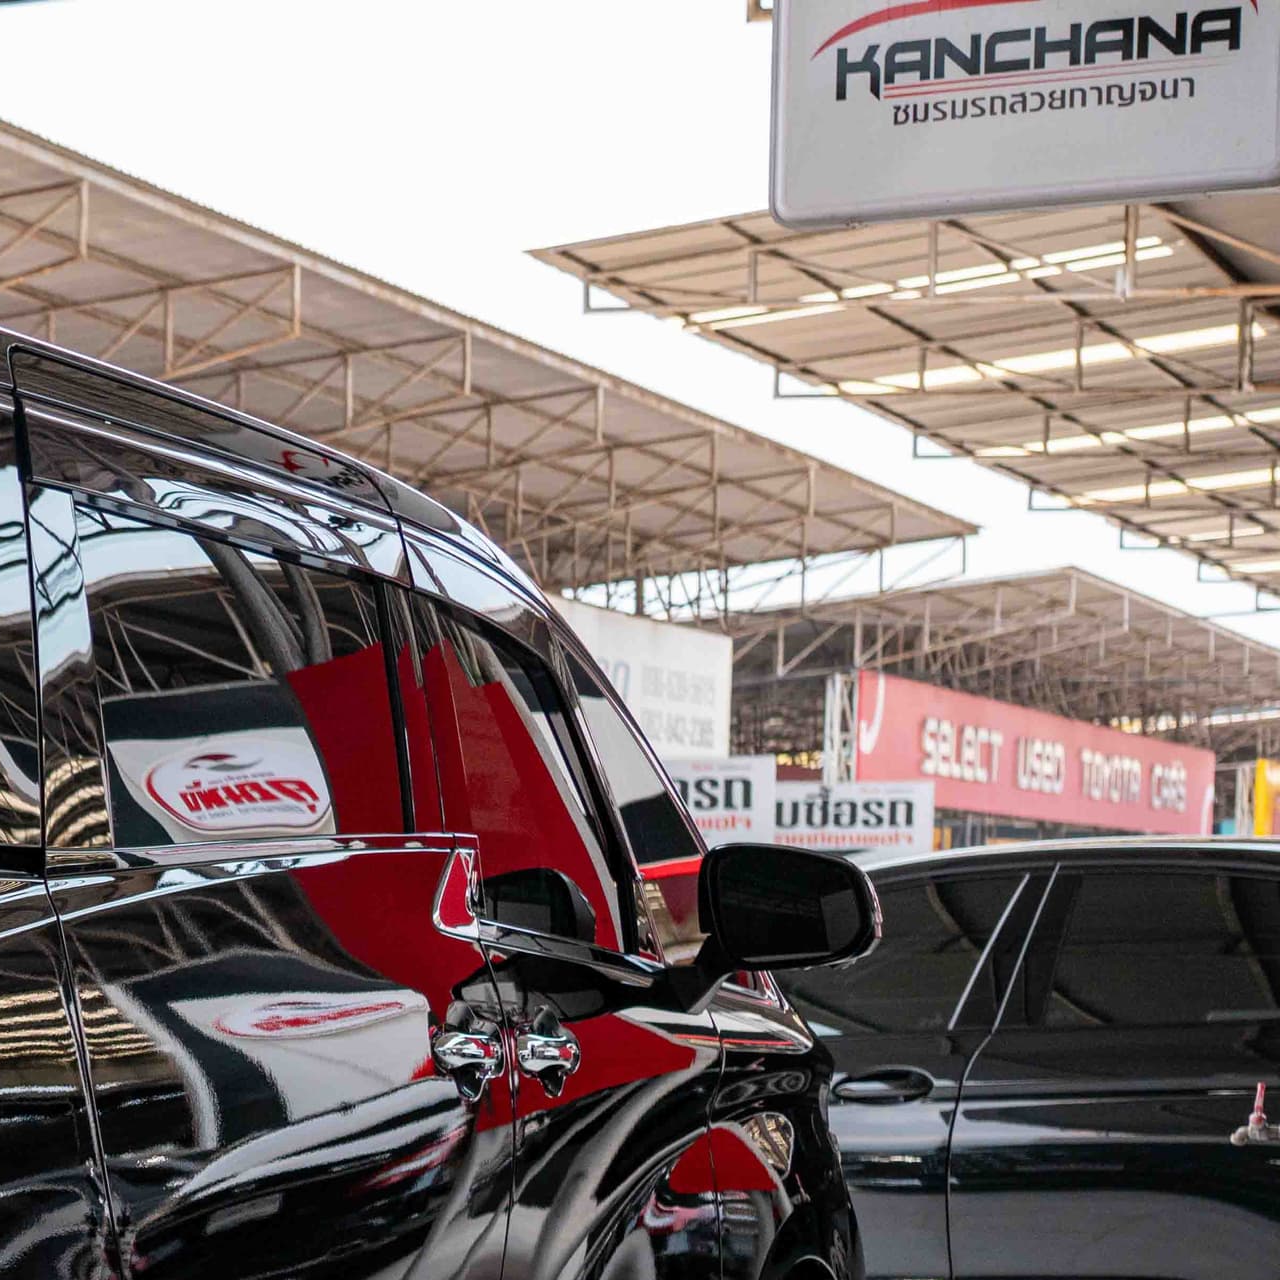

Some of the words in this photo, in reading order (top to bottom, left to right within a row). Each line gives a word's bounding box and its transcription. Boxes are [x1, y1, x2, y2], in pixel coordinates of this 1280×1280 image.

[835, 6, 1241, 102] KANCHANA
[892, 76, 1196, 126] ชมรมรถสวยกาญจนา
[1017, 736, 1066, 795] USED
[1080, 747, 1141, 803] TOYOTA
